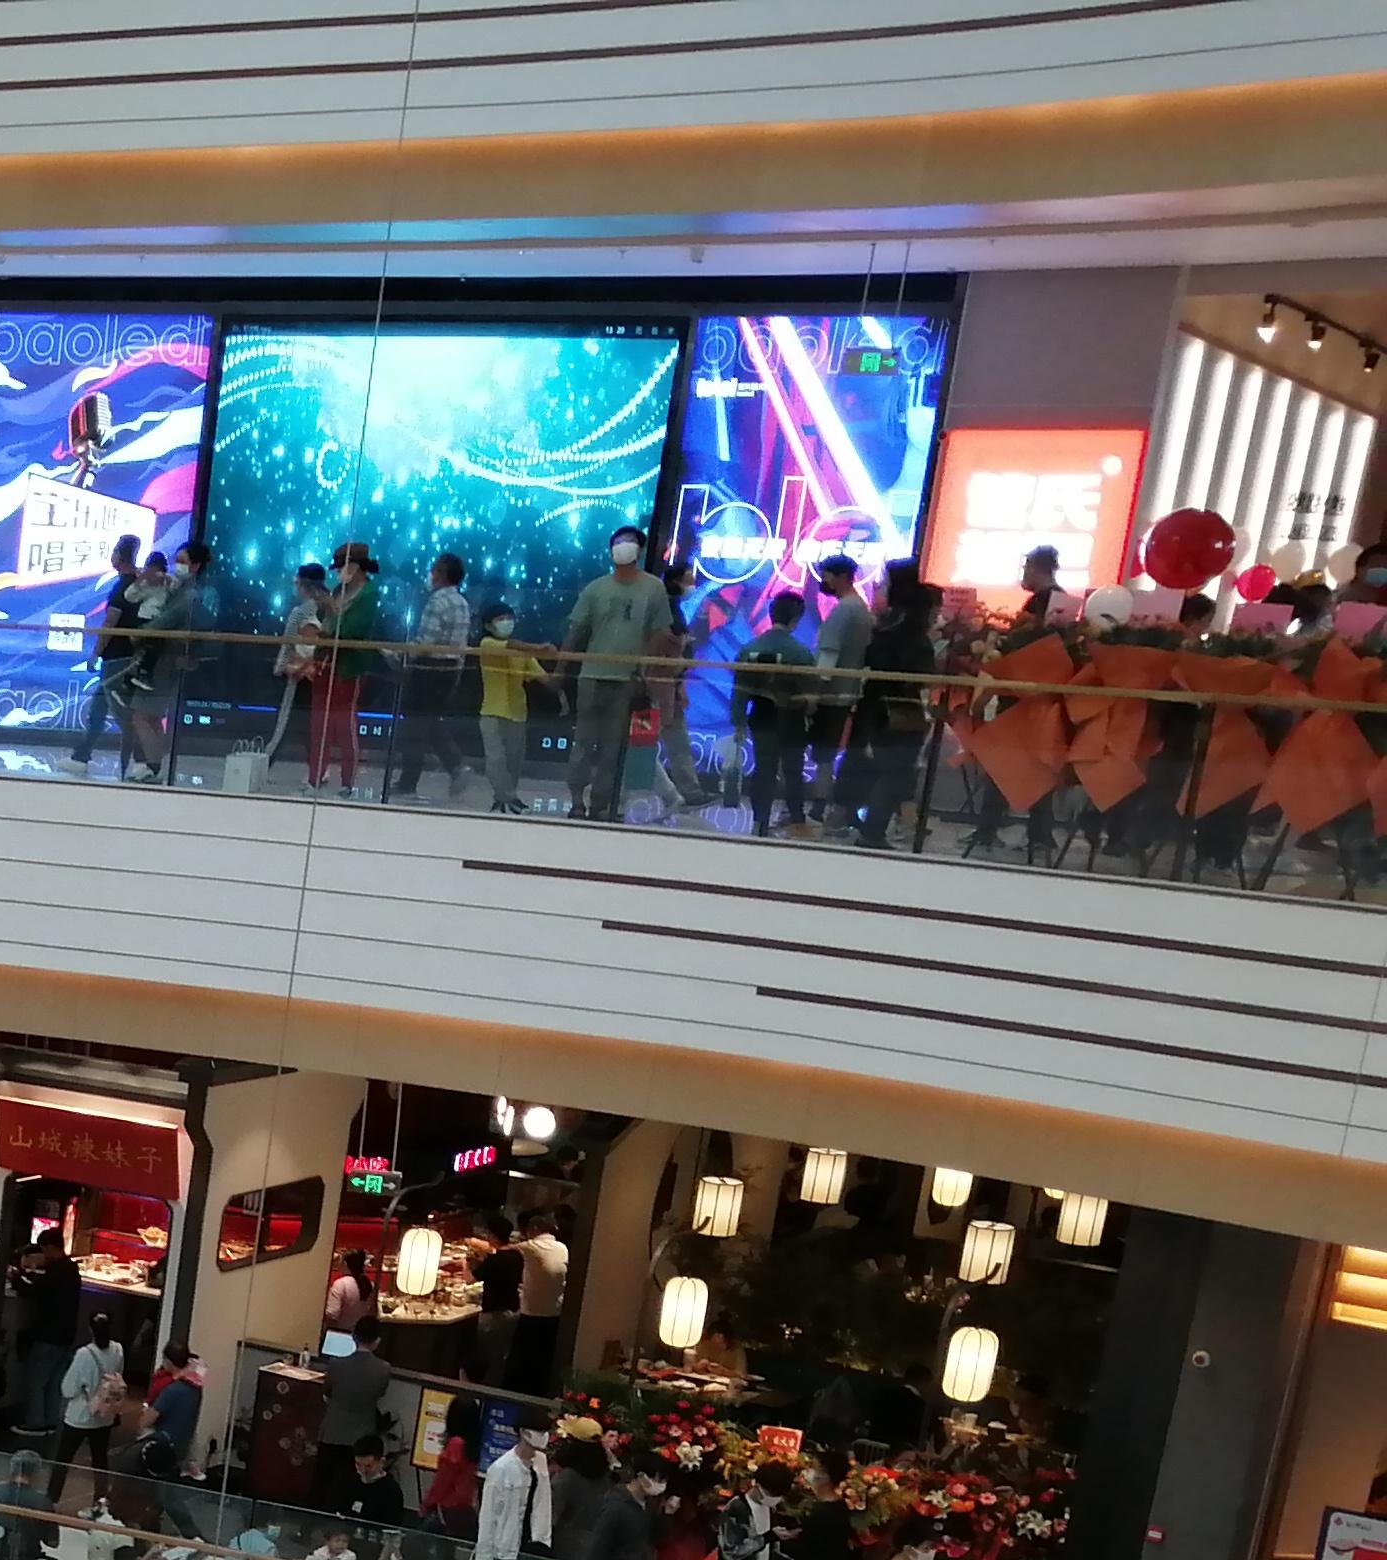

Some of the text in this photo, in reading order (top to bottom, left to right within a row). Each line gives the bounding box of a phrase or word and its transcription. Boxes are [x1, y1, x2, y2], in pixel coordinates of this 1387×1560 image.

[10, 1125, 163, 1174] 山城辣妹子
